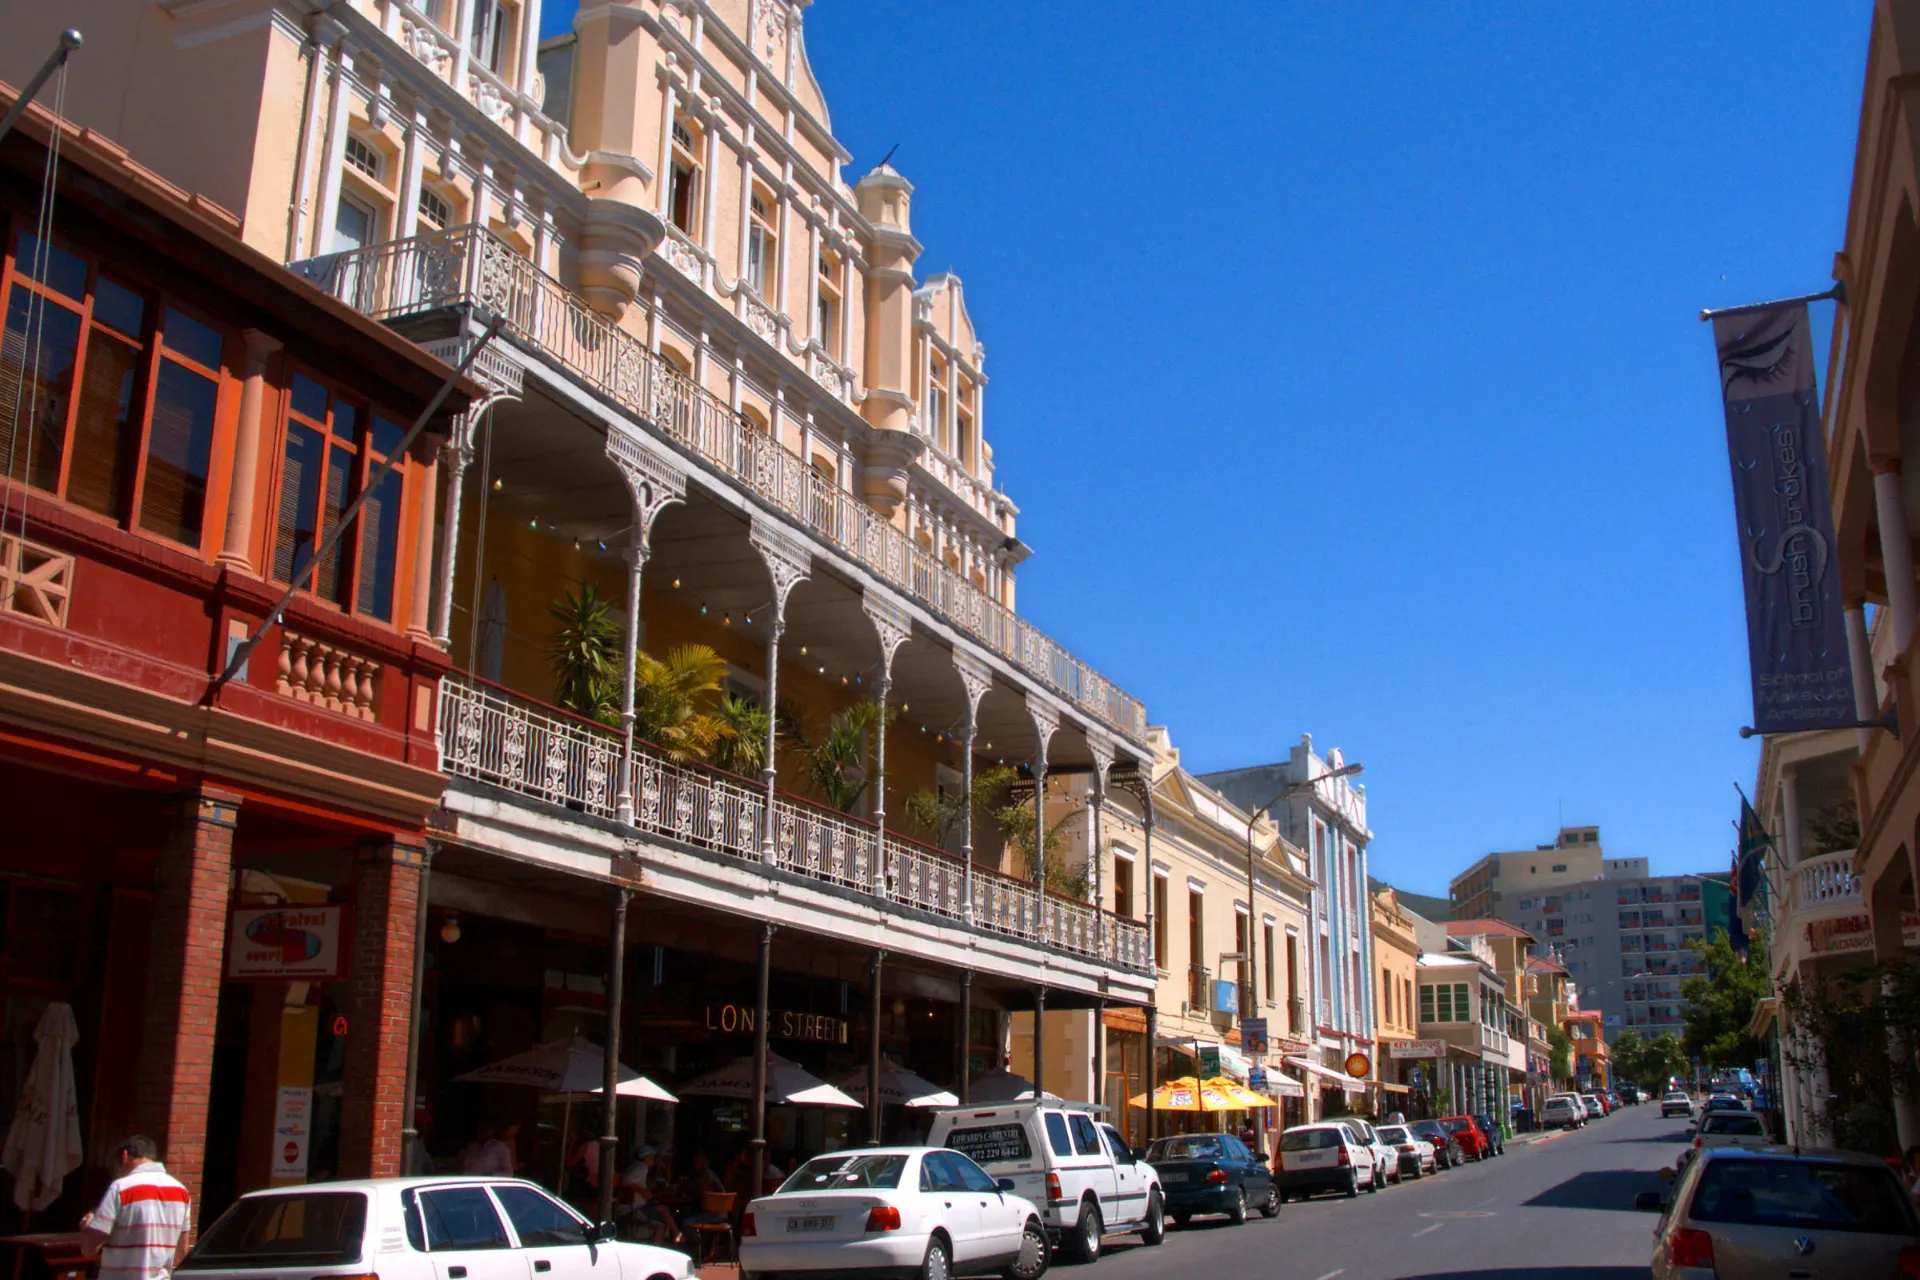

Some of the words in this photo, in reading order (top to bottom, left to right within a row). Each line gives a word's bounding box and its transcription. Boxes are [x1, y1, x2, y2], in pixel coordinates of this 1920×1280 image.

[1758, 670, 1824, 686] School
[1826, 667, 1846, 682] of
[1766, 705, 1848, 722] Artistry
[782, 1011, 836, 1042] STREET
[1394, 1039, 1409, 1049] KEY
